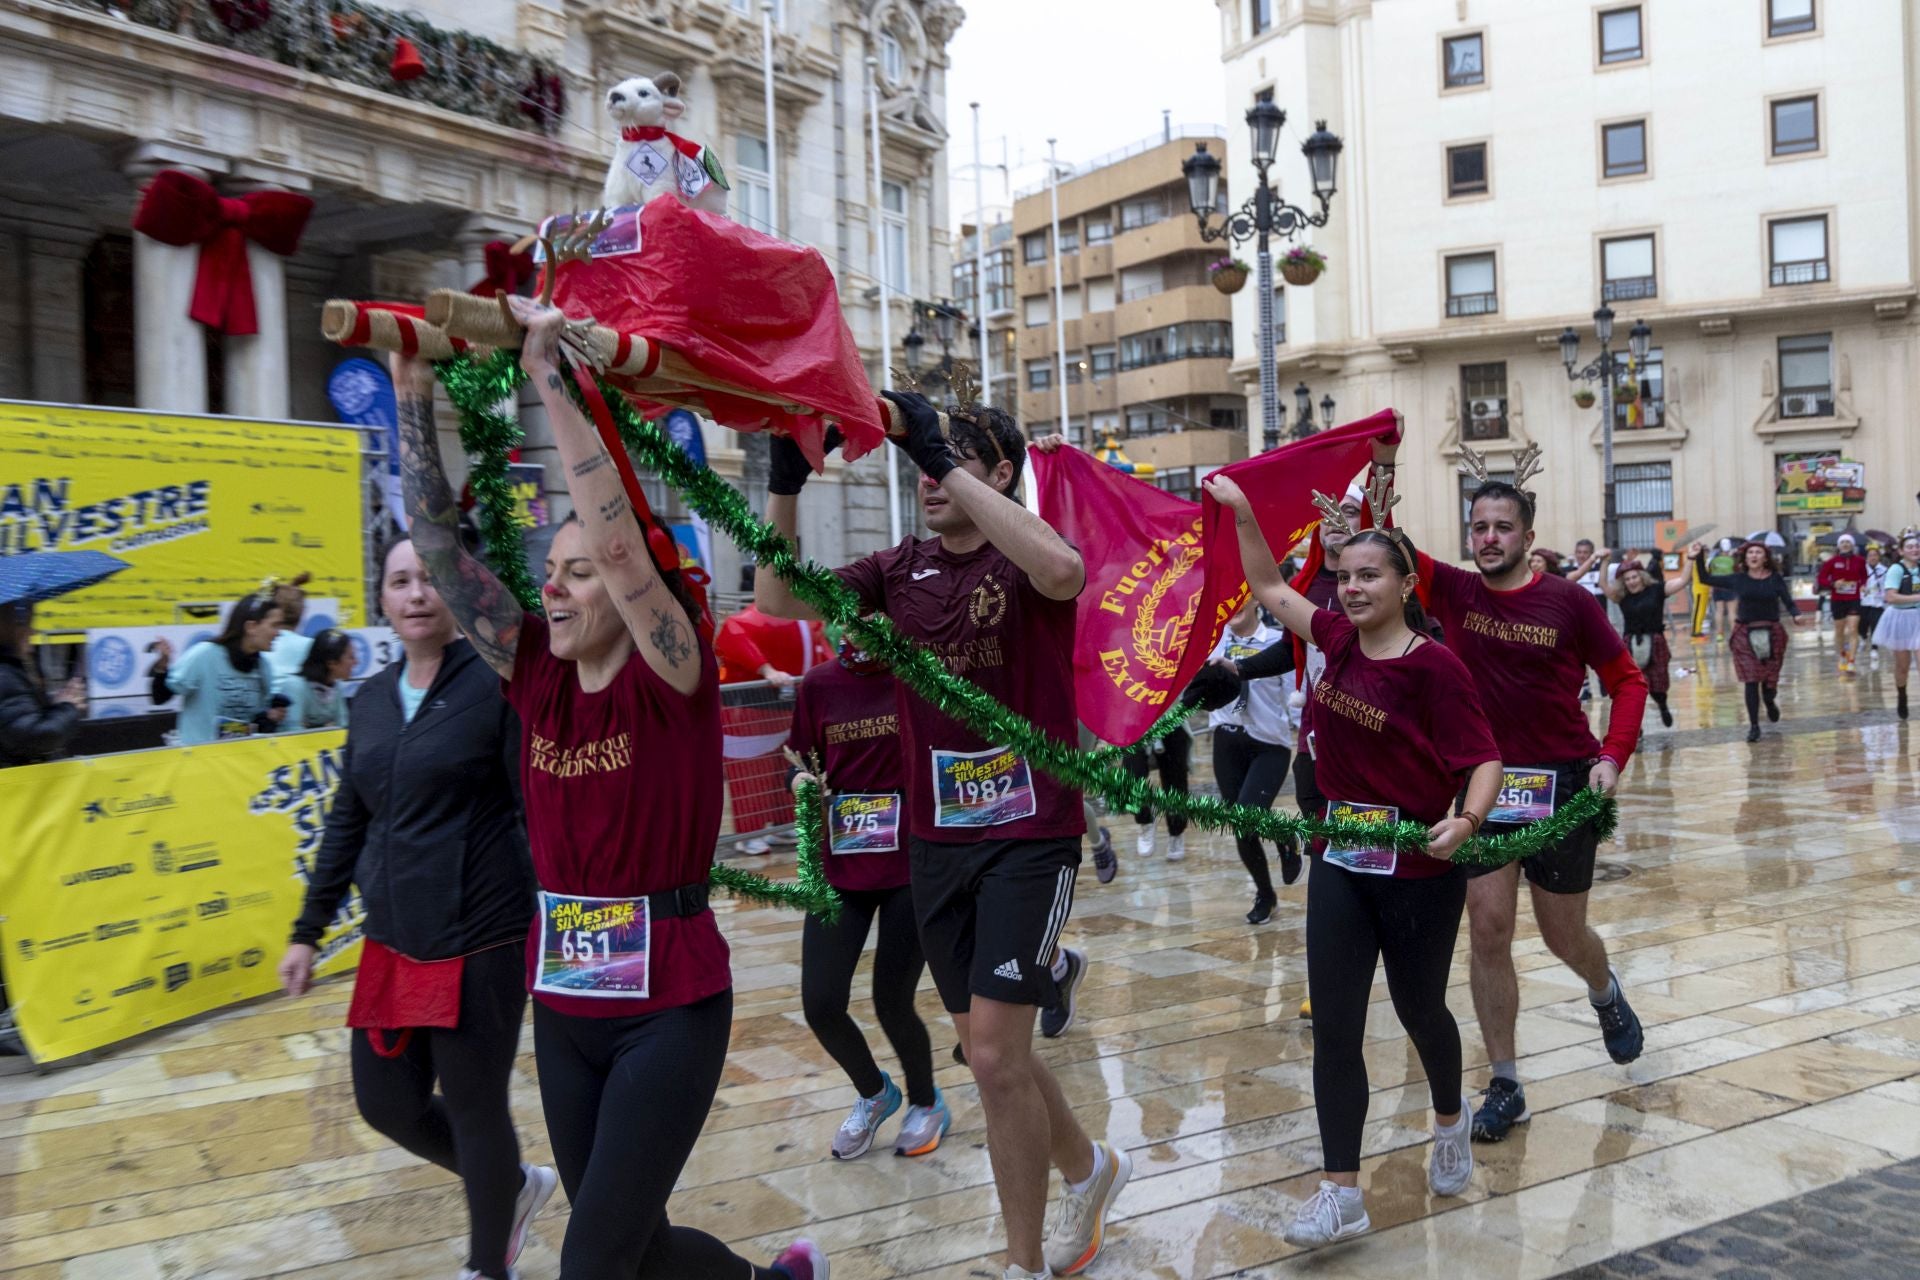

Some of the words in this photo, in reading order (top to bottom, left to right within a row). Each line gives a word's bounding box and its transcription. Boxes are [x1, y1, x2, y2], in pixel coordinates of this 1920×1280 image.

[1513, 623, 1558, 637] CHOQUE
[376, 641, 392, 665] 3
[1098, 646, 1168, 706] Extra
[1346, 695, 1388, 721] CHOQUE
[860, 718, 875, 728] DE
[954, 760, 974, 773] SAN
[955, 752, 1017, 782] SILVESTRE
[955, 775, 1016, 805] 1982
[1496, 788, 1533, 807] 650
[1338, 806, 1352, 815] SAN
[843, 813, 879, 834] 975
[556, 902, 634, 931] SILVESTRE
[557, 902, 582, 917] SAN
[562, 930, 611, 962] 651
[994, 968, 1022, 981] adidas
